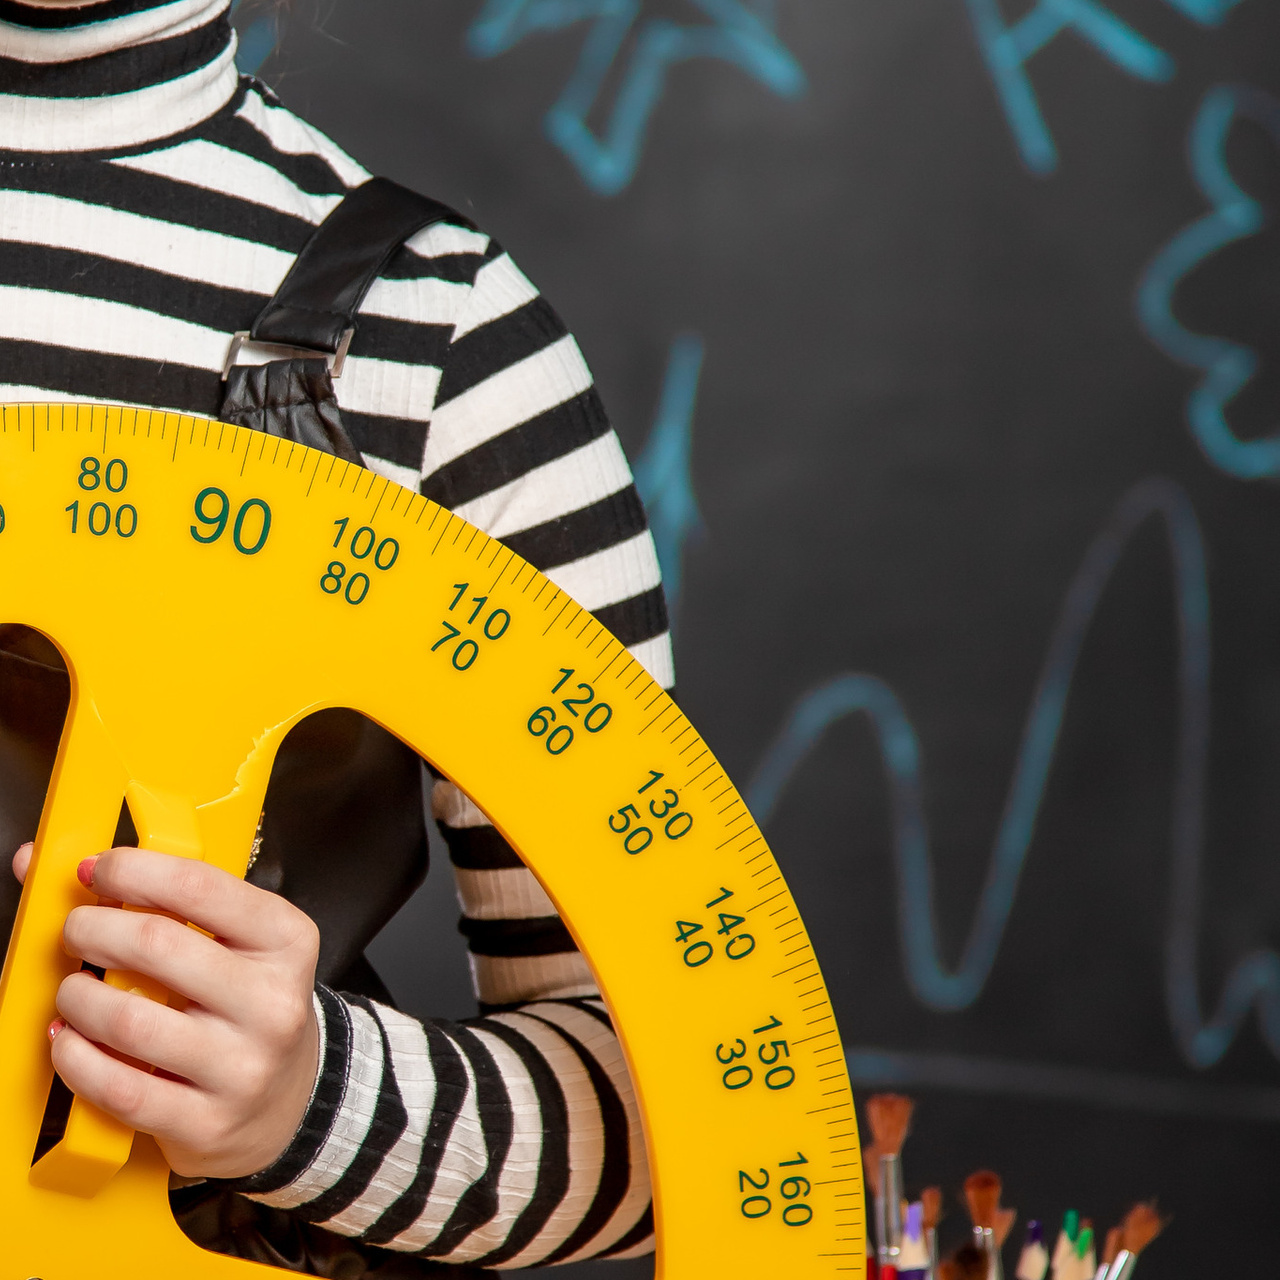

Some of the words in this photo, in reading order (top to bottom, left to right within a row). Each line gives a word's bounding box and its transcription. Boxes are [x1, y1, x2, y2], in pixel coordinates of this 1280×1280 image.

[78, 456, 128, 493] 80
[65, 500, 138, 538] 100
[190, 487, 272, 555] 90
[333, 517, 399, 571] 100
[320, 561, 370, 605] 80
[448, 583, 510, 641] 110
[431, 621, 479, 671] 70
[551, 668, 612, 733] 120
[527, 706, 574, 755] 60
[608, 804, 653, 855] 50
[636, 770, 693, 841] 130
[675, 920, 713, 967] 40
[705, 887, 755, 960] 140
[715, 1038, 753, 1090] 30
[752, 1015, 795, 1090] 150
[738, 1167, 771, 1219] 20
[778, 1151, 812, 1227] 160
